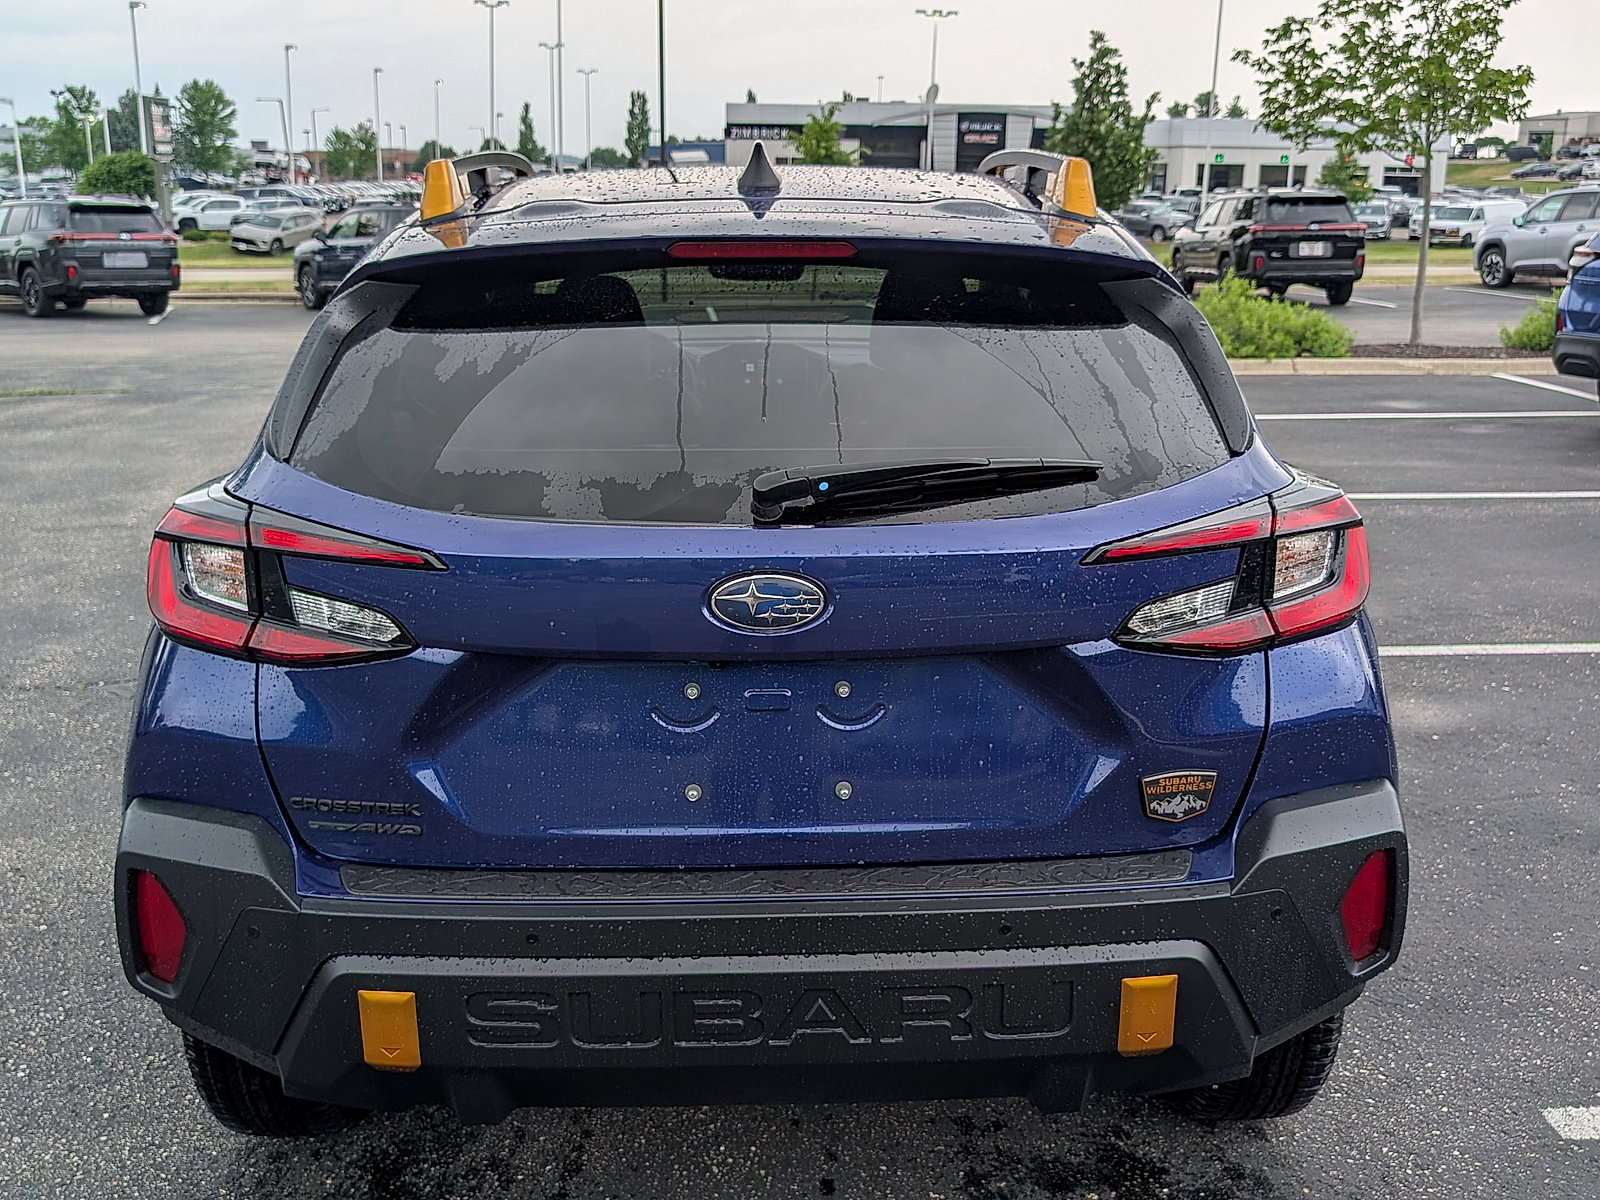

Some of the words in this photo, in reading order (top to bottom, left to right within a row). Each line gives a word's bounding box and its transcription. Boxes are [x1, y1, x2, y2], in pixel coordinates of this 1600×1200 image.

[730, 126, 790, 139] ZIMBRICK
[1159, 776, 1202, 785] SUBARU
[1146, 782, 1213, 794] WILDERNESS
[290, 797, 421, 816] CROSSTREK
[464, 981, 1075, 1048] SUBARU
